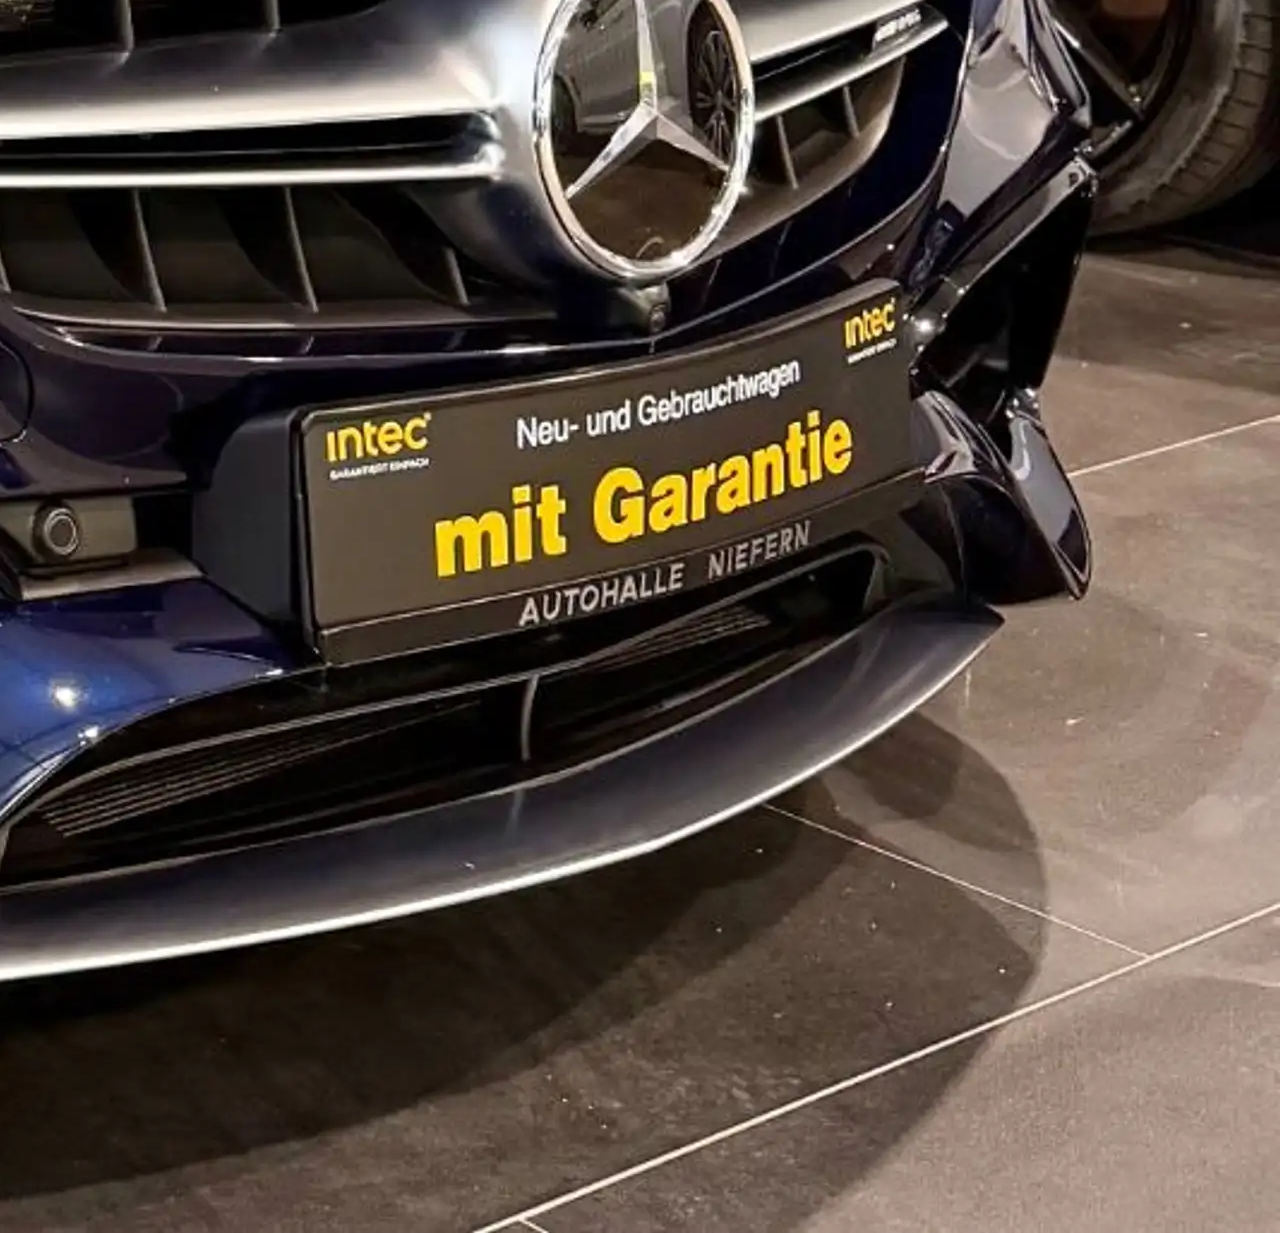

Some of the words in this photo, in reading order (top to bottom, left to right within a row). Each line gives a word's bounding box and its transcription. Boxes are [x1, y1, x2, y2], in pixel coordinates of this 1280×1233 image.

[515, 417, 580, 450] Neu-
[586, 399, 631, 437] und
[638, 359, 801, 425] Gebrauchtwagen
[435, 484, 567, 578] mit
[593, 409, 853, 544] Garantie
[518, 563, 685, 626] AUTOHALLE
[707, 520, 812, 581] NIEFERN
